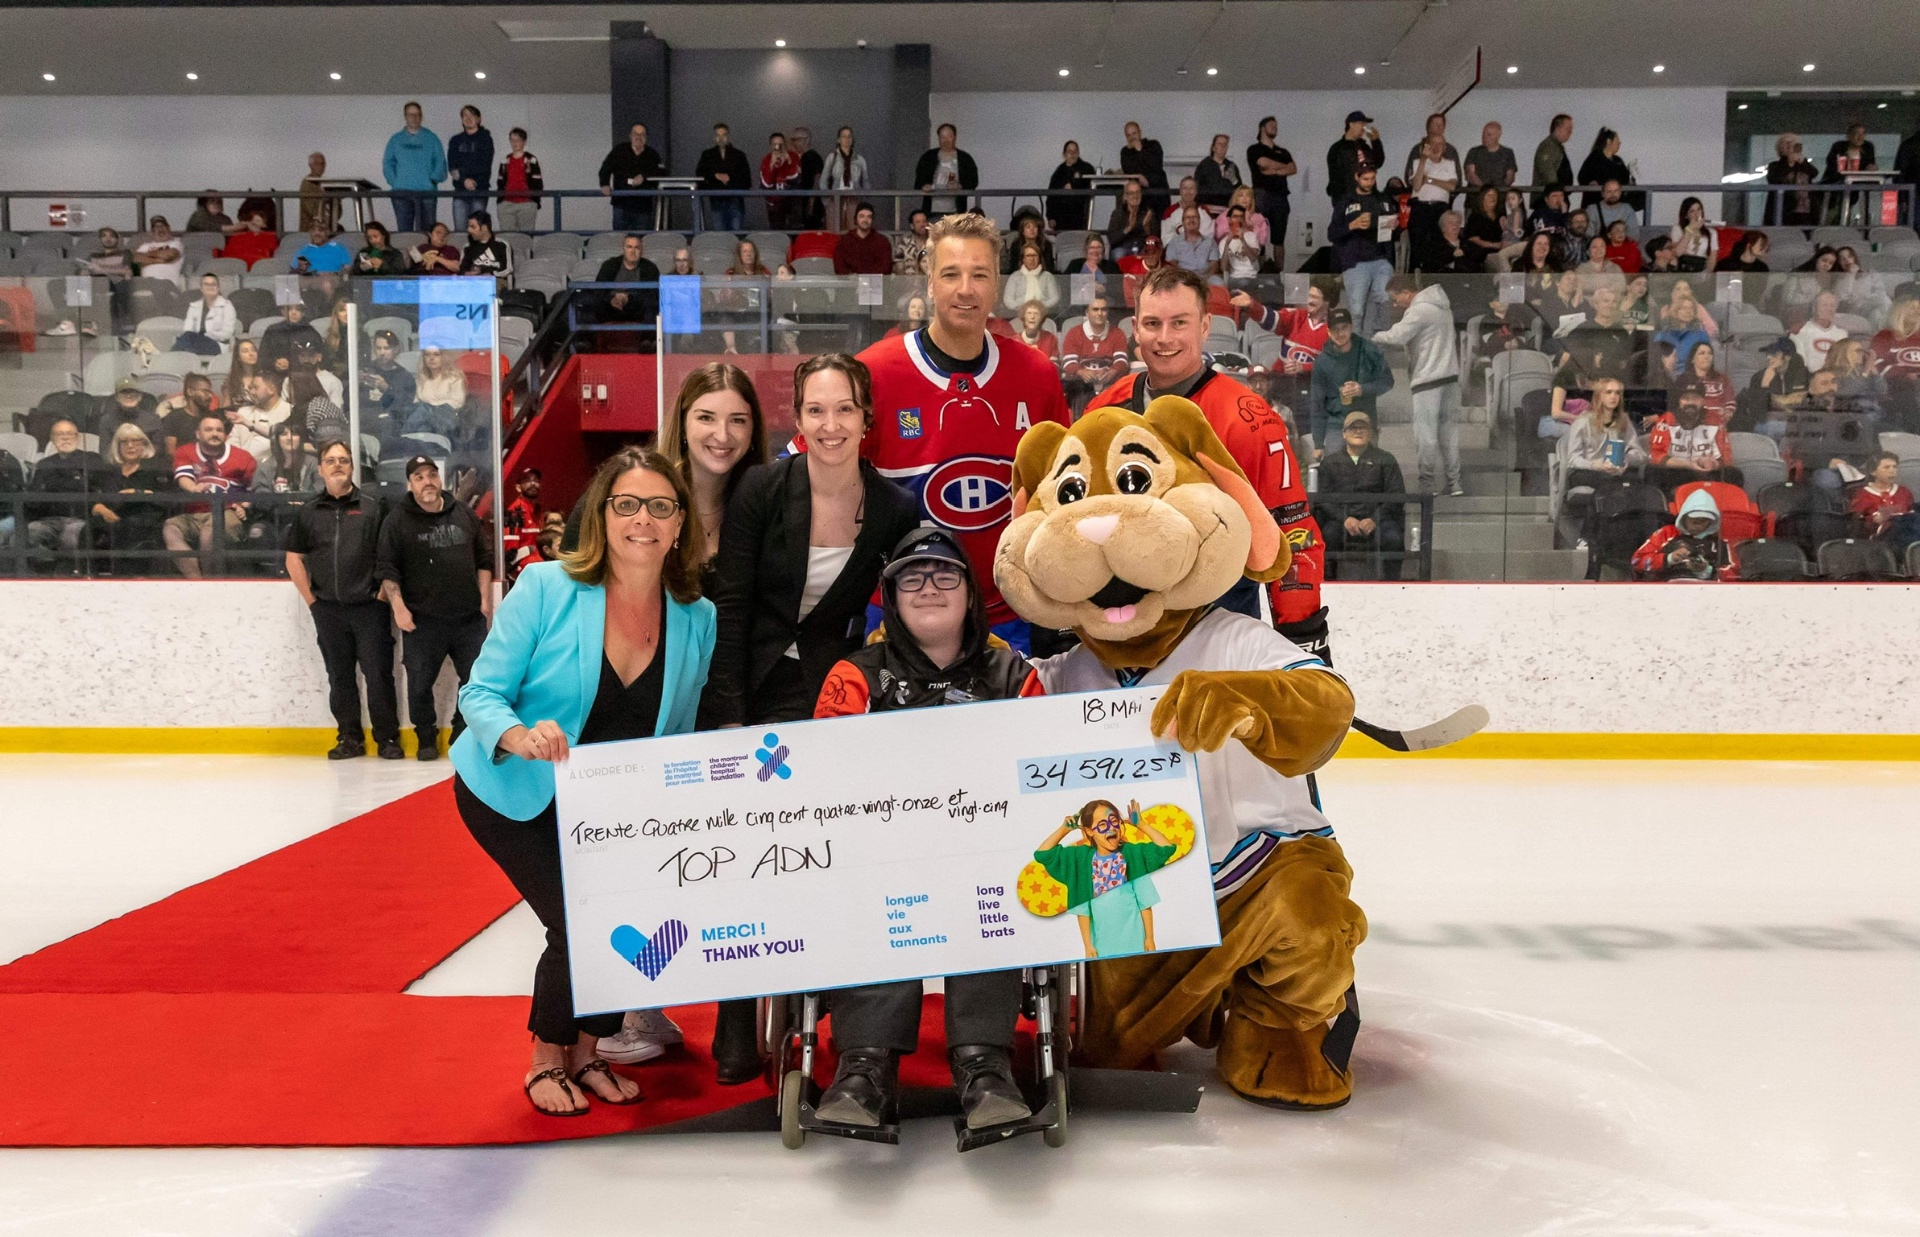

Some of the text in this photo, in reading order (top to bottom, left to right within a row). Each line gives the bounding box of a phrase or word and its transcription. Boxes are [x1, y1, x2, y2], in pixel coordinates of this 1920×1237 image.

[1015, 401, 1032, 430] A
[902, 428, 921, 437] RBC
[1083, 698, 1107, 724] 18
[720, 753, 749, 763] montreal
[579, 765, 622, 779] L'ORDRE
[625, 764, 638, 773] DE
[673, 765, 698, 774] l'hôpital
[710, 761, 740, 770] children's
[710, 767, 736, 775] hospital
[674, 771, 702, 779] montréal
[711, 772, 745, 782] foundation
[1024, 759, 1068, 789] 34
[681, 777, 704, 785] enfants
[948, 788, 968, 806] et
[657, 839, 831, 887] TOP ADN
[976, 885, 1005, 897] long
[885, 893, 929, 907] longue
[978, 899, 1001, 911] live
[886, 909, 906, 920] vie
[979, 912, 1010, 925] little
[701, 922, 756, 942] MERCI
[888, 924, 912, 935] aux
[981, 926, 1016, 939] brats
[890, 934, 948, 949] tannants
[702, 938, 805, 963] THANK YOU!
